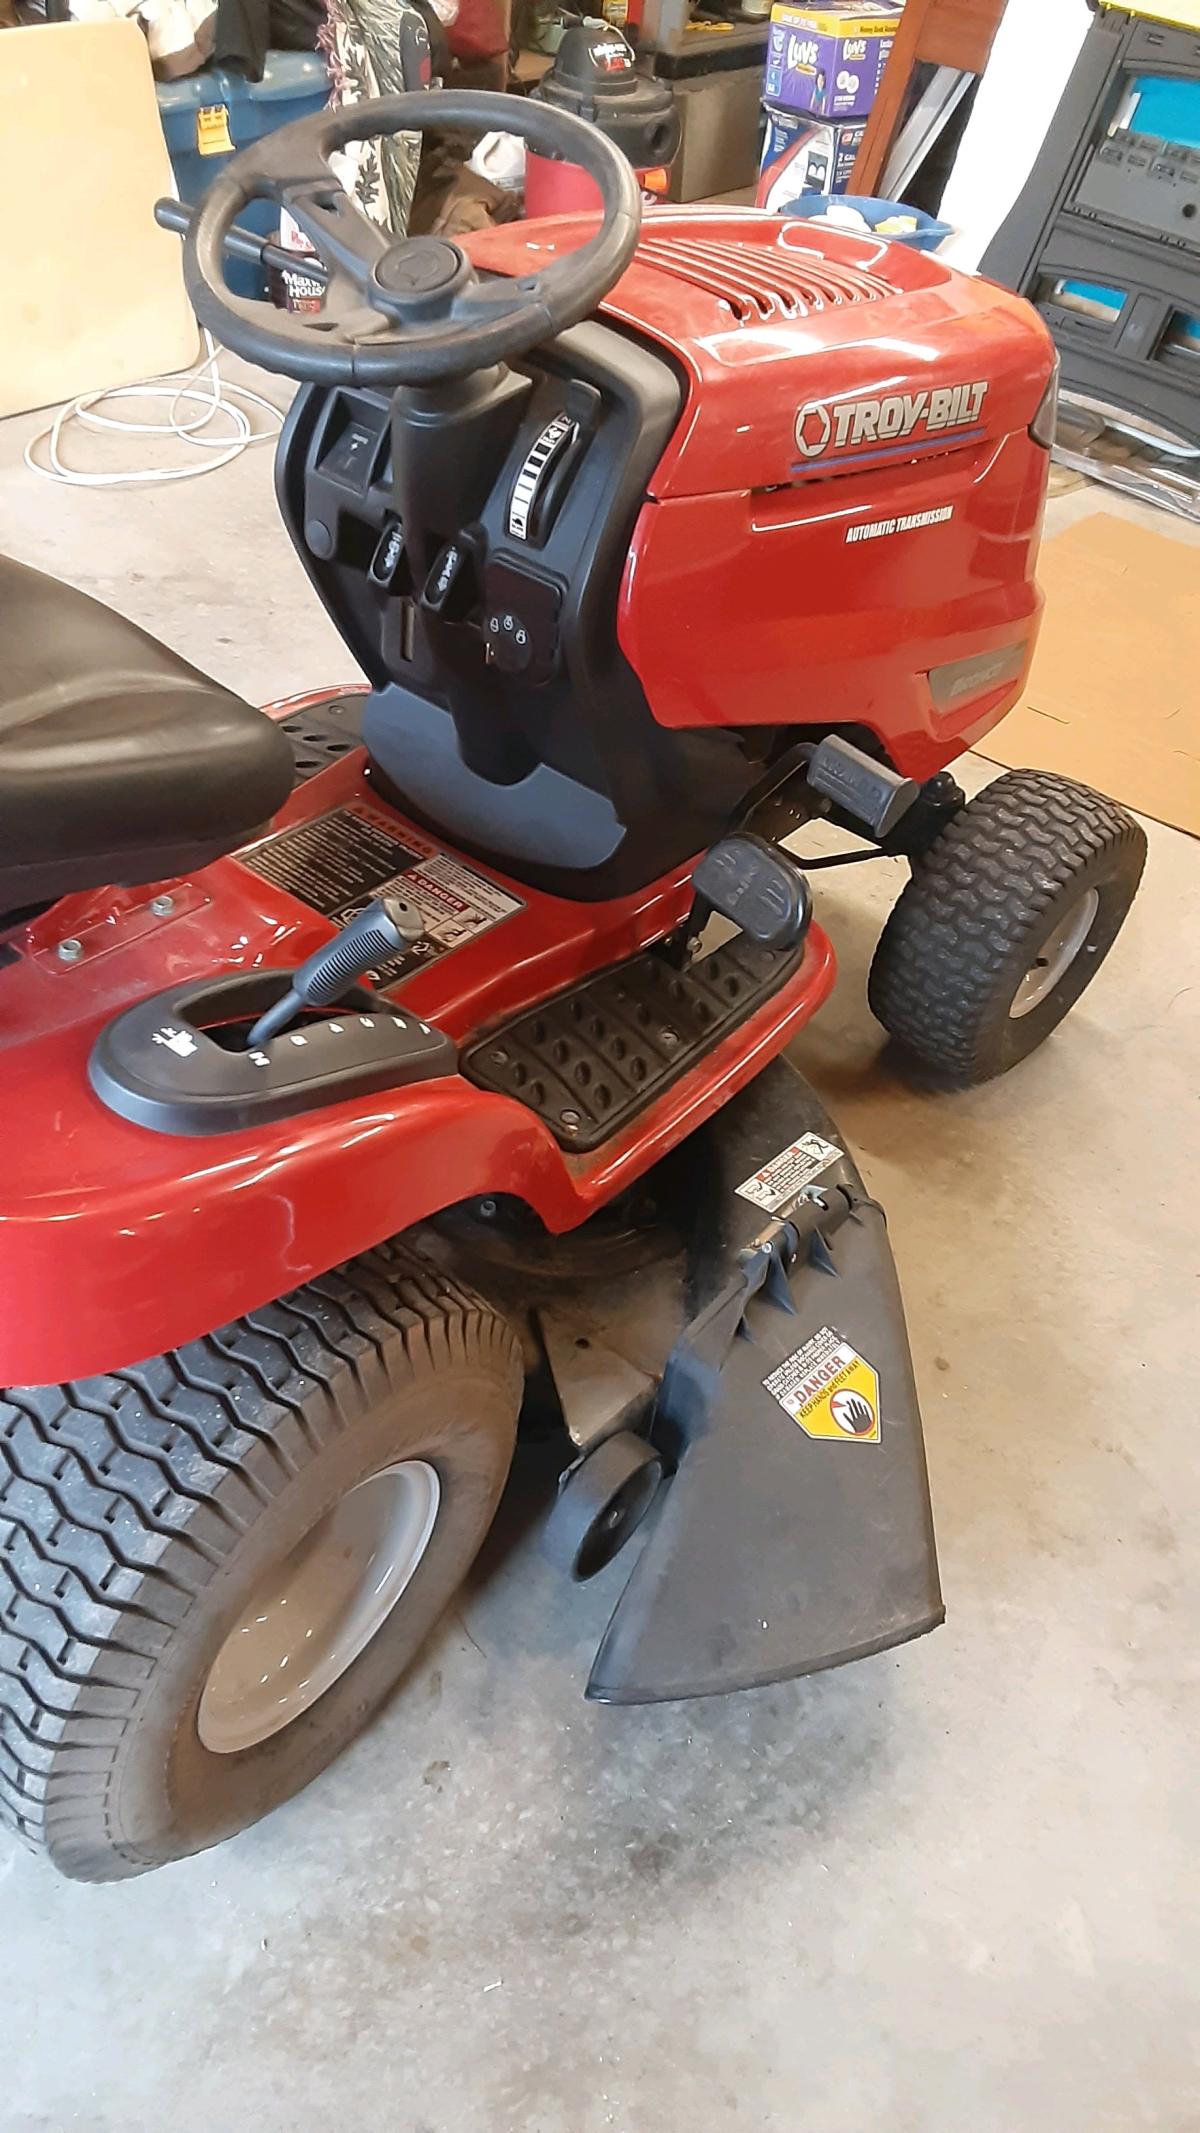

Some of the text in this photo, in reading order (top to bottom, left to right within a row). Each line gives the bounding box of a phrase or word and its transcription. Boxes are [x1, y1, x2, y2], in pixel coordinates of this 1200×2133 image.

[289, 285, 326, 298] Hous
[833, 381, 988, 447] TROY-BILT
[846, 505, 954, 543] AUTOMATIC TRANSMISSION
[417, 878, 464, 909] DANGER
[792, 1354, 846, 1403] DANGER
[798, 1359, 860, 1418] KEEP HANDS and FEET AWAY
